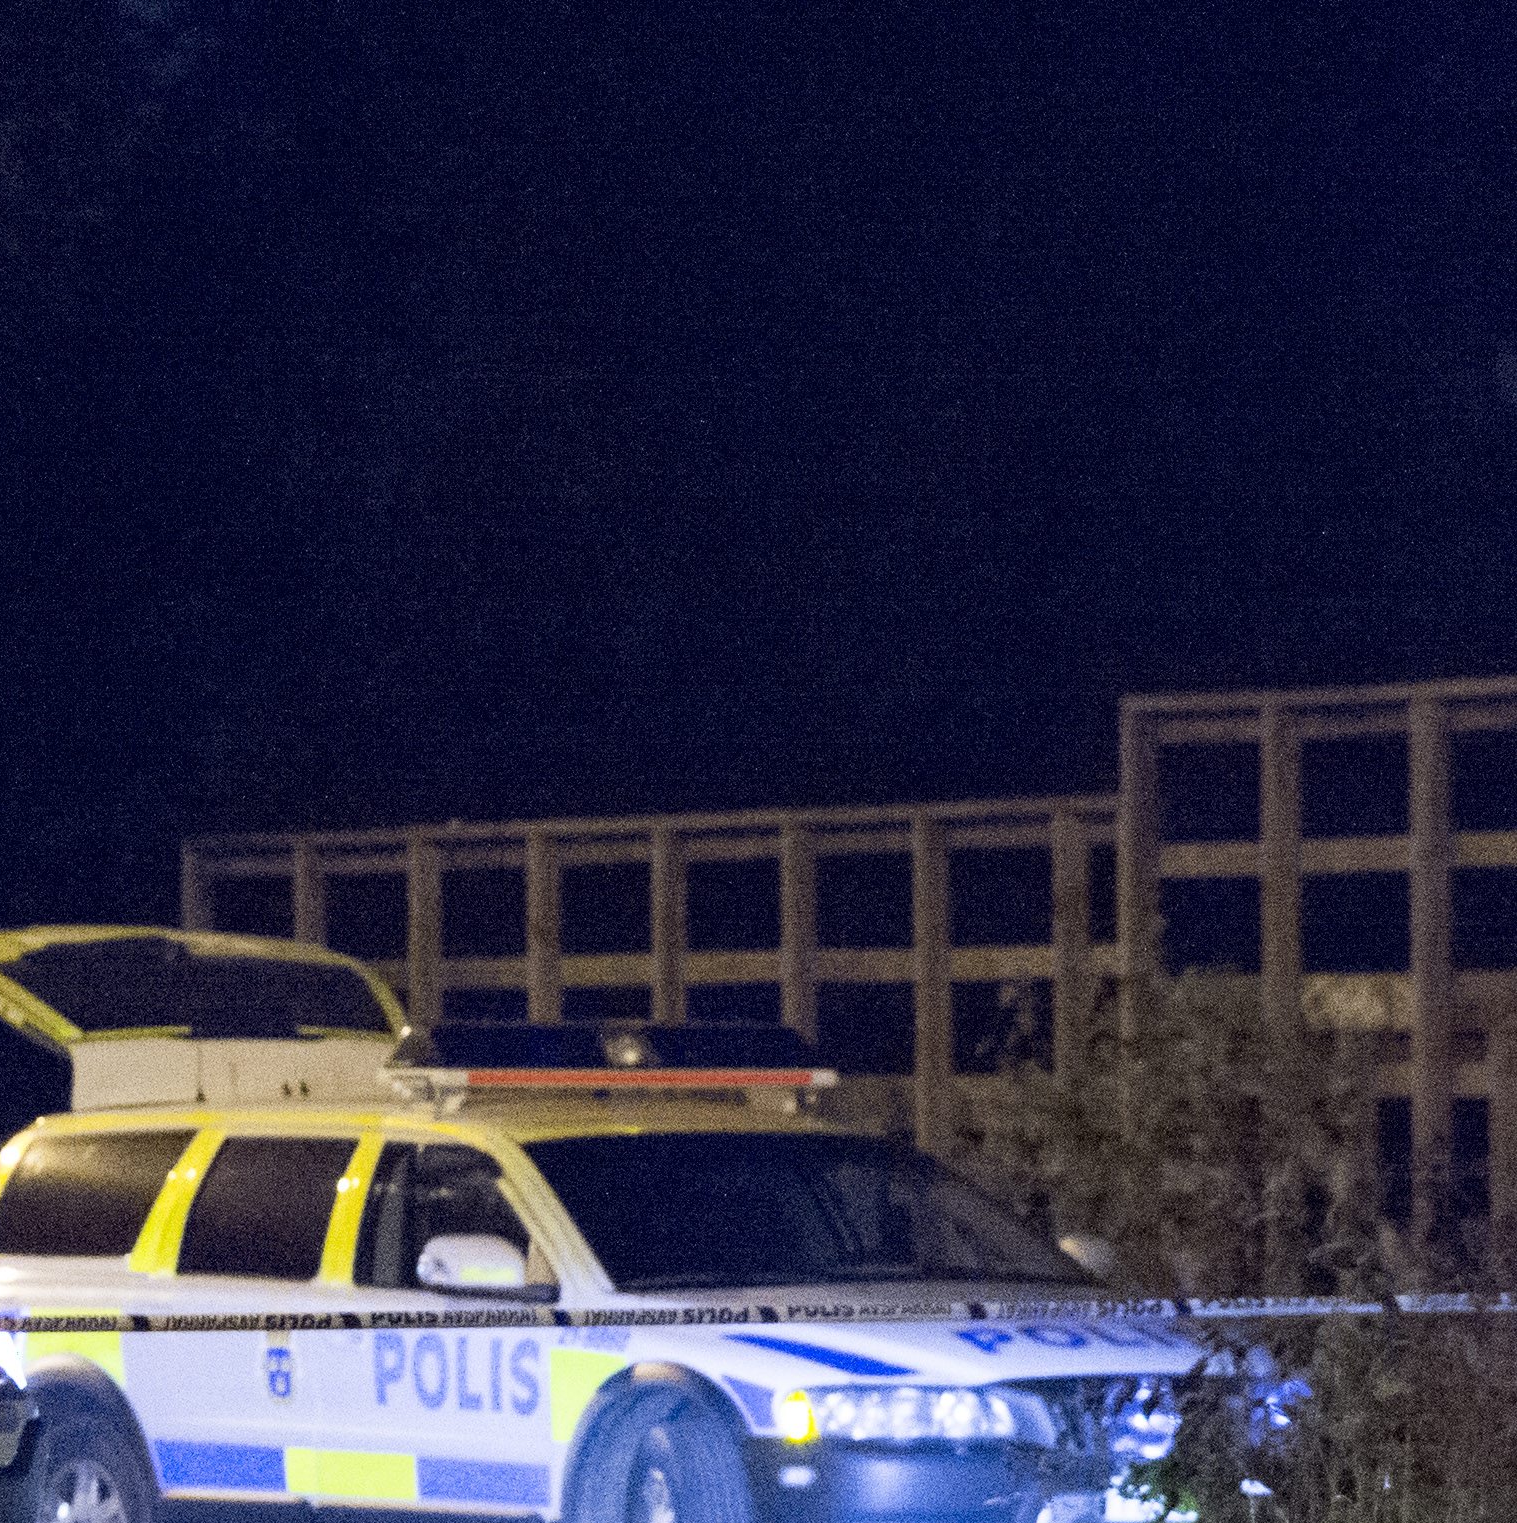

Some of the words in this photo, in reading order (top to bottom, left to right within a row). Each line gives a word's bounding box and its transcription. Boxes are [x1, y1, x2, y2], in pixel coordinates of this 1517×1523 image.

[264, 1314, 333, 1331] POLIS
[682, 1307, 750, 1325] POLIS
[373, 1332, 541, 1416] POLIS
